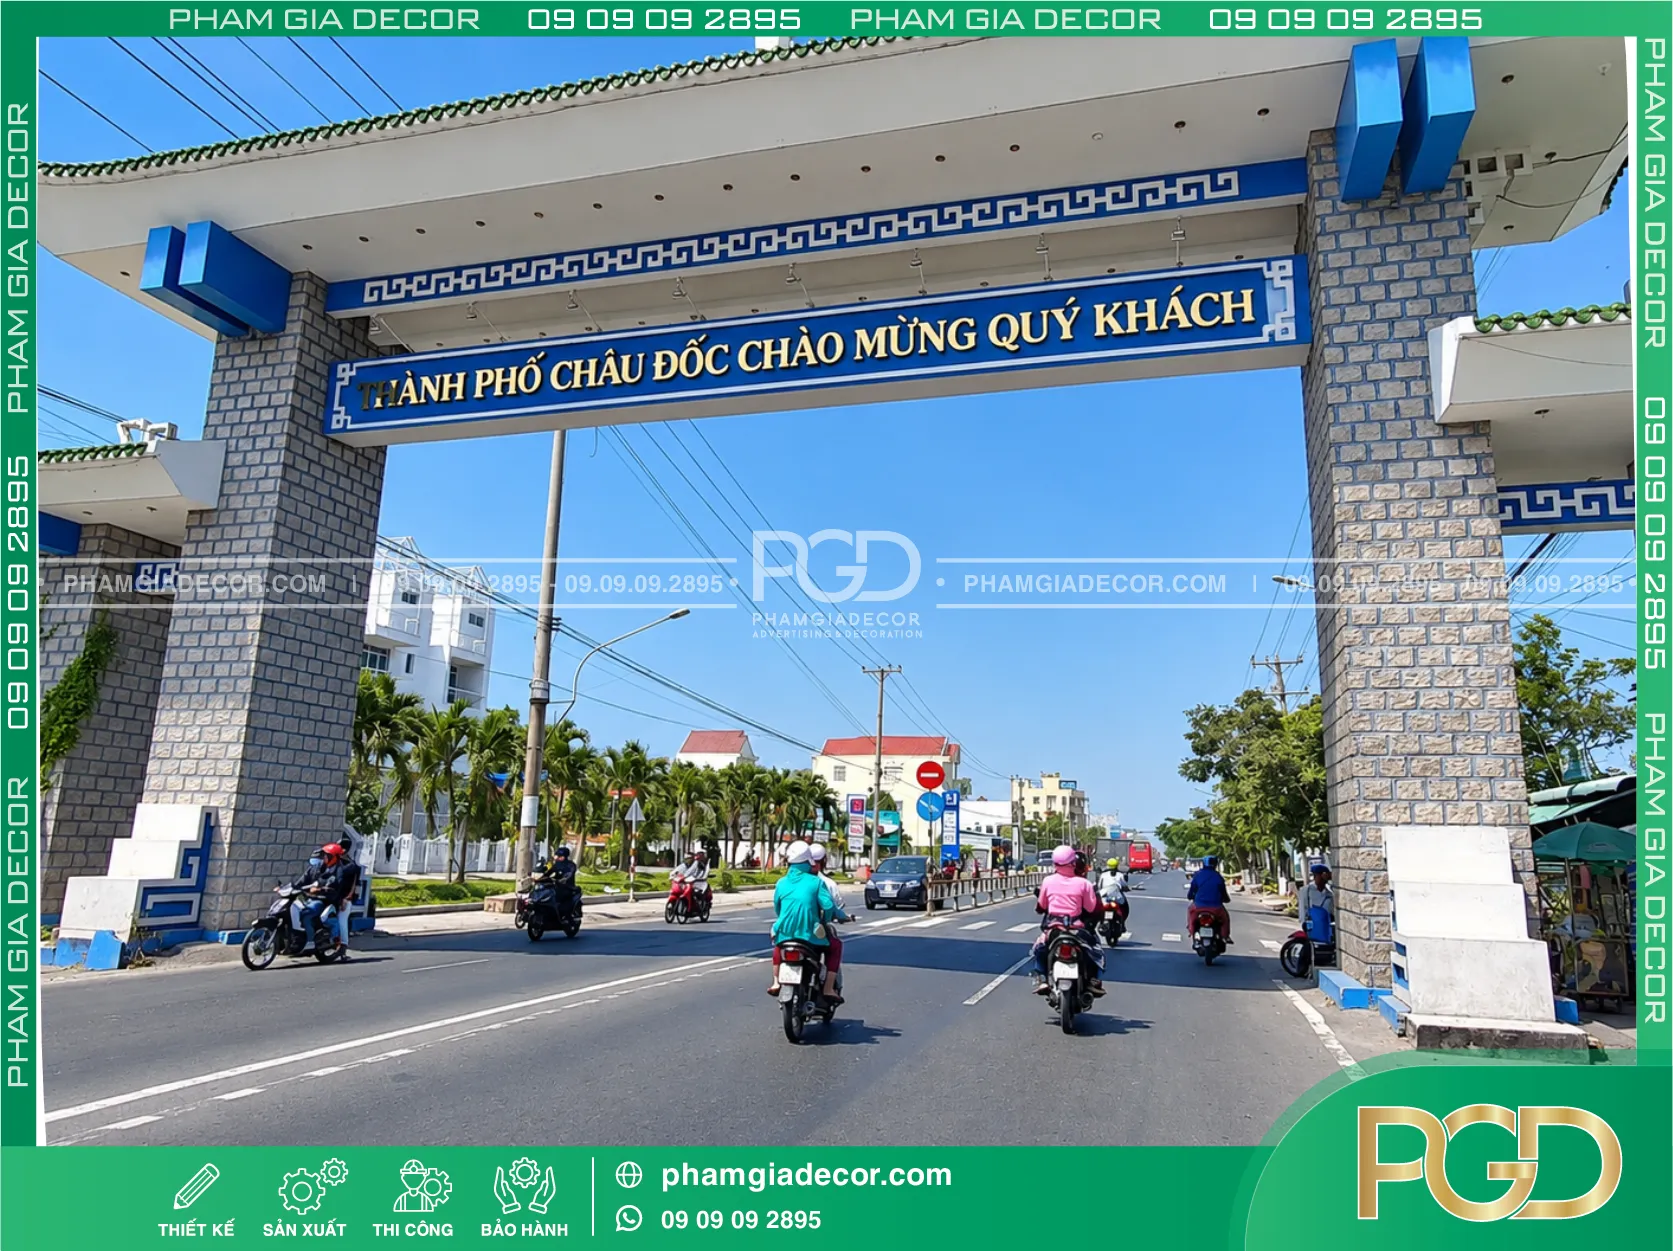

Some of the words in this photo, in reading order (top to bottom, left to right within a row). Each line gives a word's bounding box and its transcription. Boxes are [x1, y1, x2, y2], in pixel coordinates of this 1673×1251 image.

[357, 371, 464, 410] THÀNH
[474, 351, 547, 398] PHỐ
[550, 348, 645, 390] CHÂU
[653, 334, 729, 382] ĐỐC
[737, 325, 844, 373] CHÀO
[854, 314, 977, 361] MỪNG
[988, 296, 1082, 352] QUÝ
[1094, 284, 1255, 337] KHÁCH
